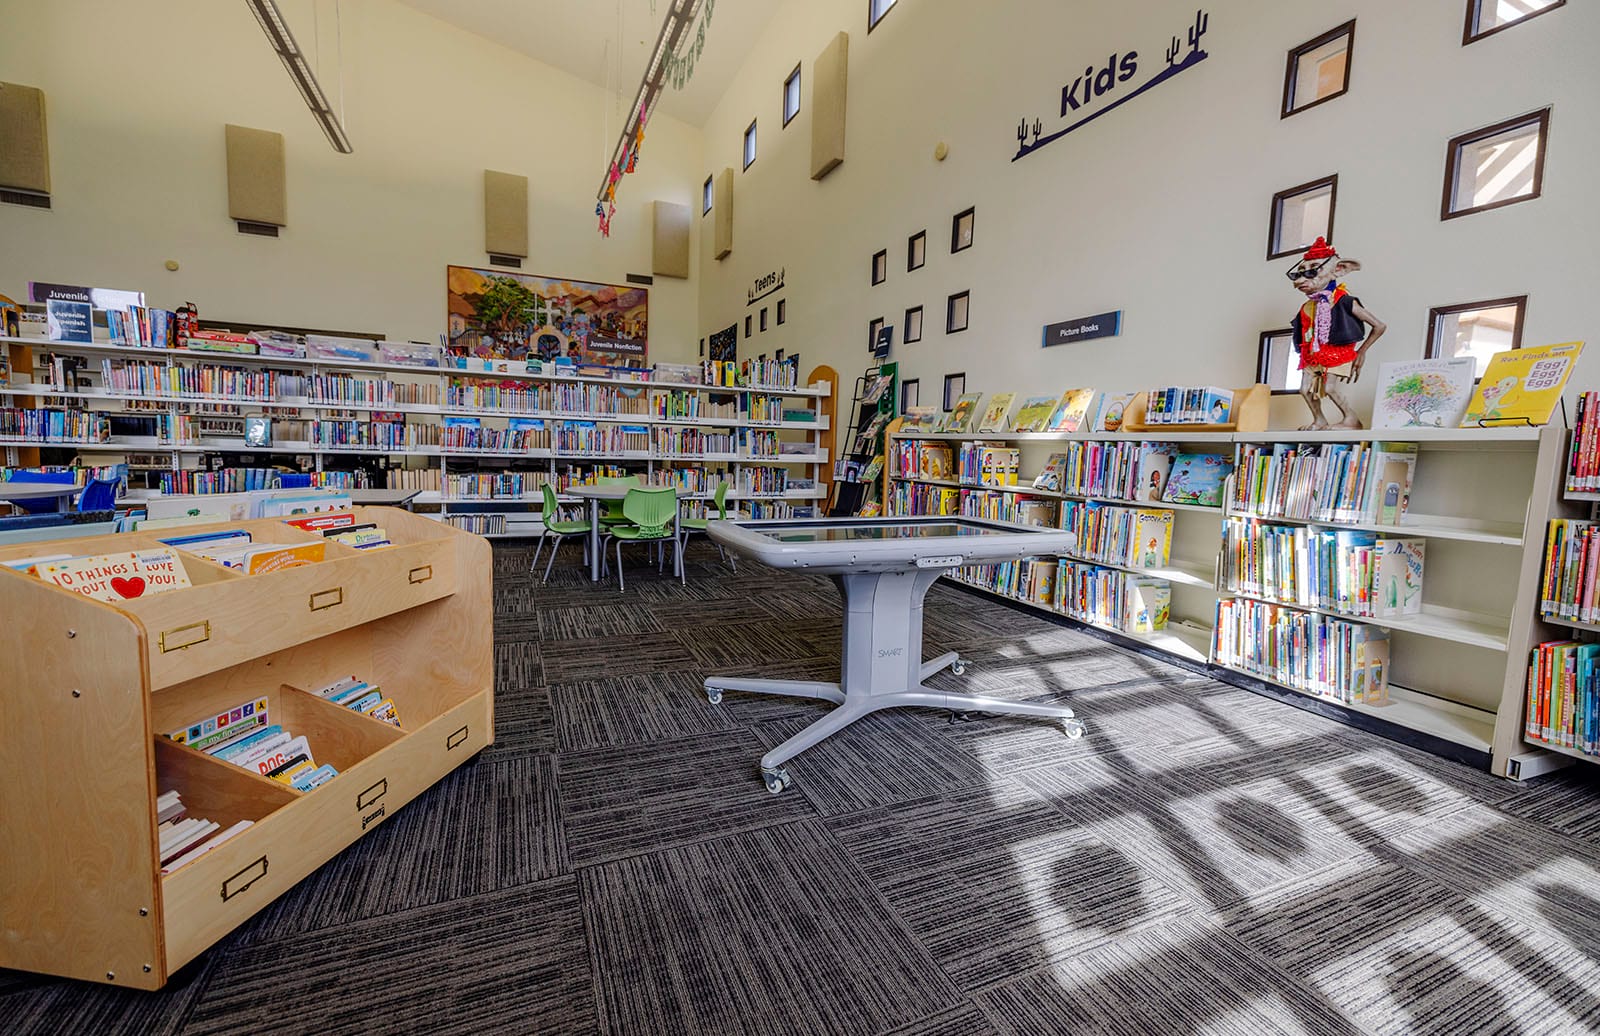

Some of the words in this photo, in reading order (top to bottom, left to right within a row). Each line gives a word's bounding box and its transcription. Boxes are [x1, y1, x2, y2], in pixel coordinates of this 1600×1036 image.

[1060, 51, 1138, 118] Kids
[754, 271, 776, 293] Teens
[48, 290, 89, 301] Juvenile
[54, 311, 86, 319] Juvenile
[1060, 328, 1080, 337] Picture
[1080, 324, 1099, 334] Books
[1522, 351, 1549, 360] Finds
[1535, 359, 1568, 370] Egg!
[1531, 367, 1564, 379] Egg!
[1527, 376, 1559, 388] Egg!
[75, 563, 128, 582] THINGS
[132, 562, 139, 573] I
[147, 574, 176, 586] YOU!
[878, 647, 904, 658] SMART
[258, 753, 286, 776] DOG
